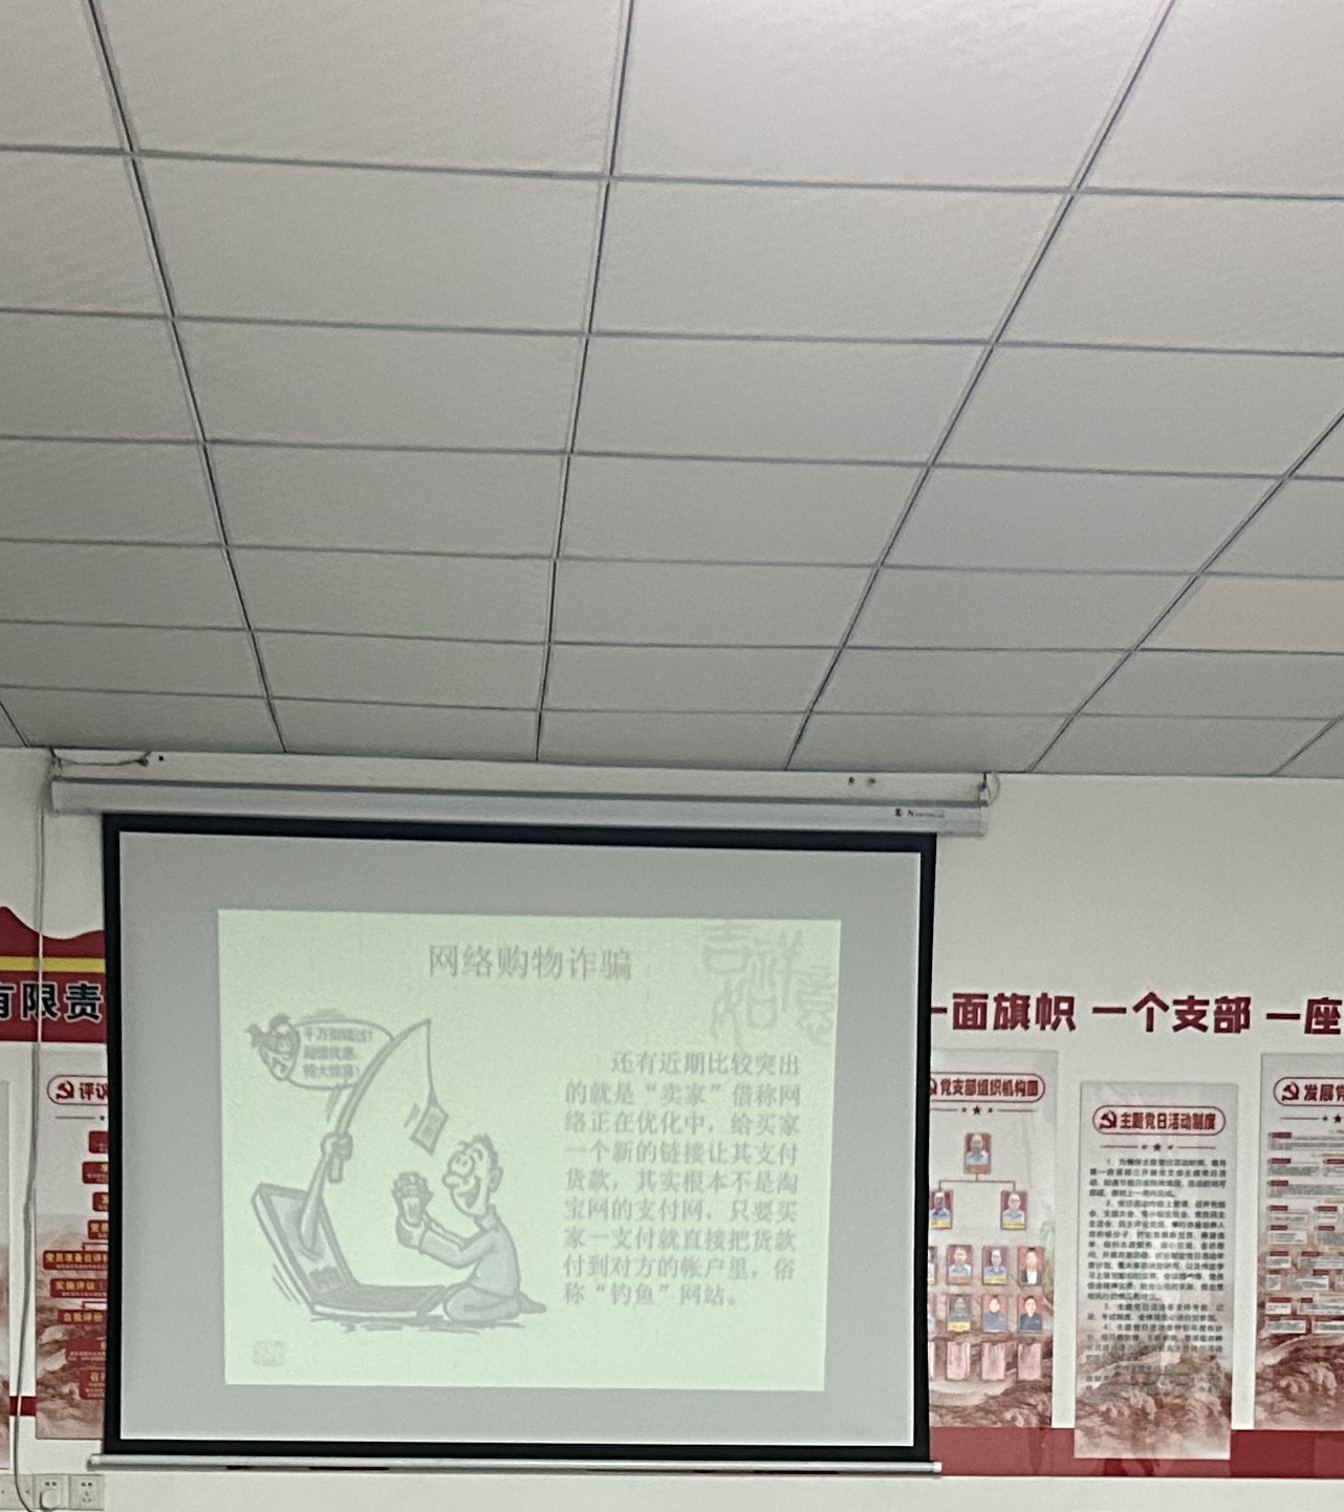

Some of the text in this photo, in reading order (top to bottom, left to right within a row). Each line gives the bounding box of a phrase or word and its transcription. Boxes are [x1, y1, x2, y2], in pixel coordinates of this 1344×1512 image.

[429, 944, 632, 981] 网络购物诈骗
[1093, 992, 1252, 1034] 一个支部
[611, 1050, 799, 1076] 还有近期比较突出
[1120, 1111, 1217, 1131] 主题党日活动制度
[563, 1139, 798, 1167] 一个新的链接让其支付
[564, 1168, 798, 1195] 货款，其实根本不是淘
[563, 1196, 798, 1224] 宝网的支付网，只要买
[563, 1226, 797, 1253] 家一支付就直接把货款
